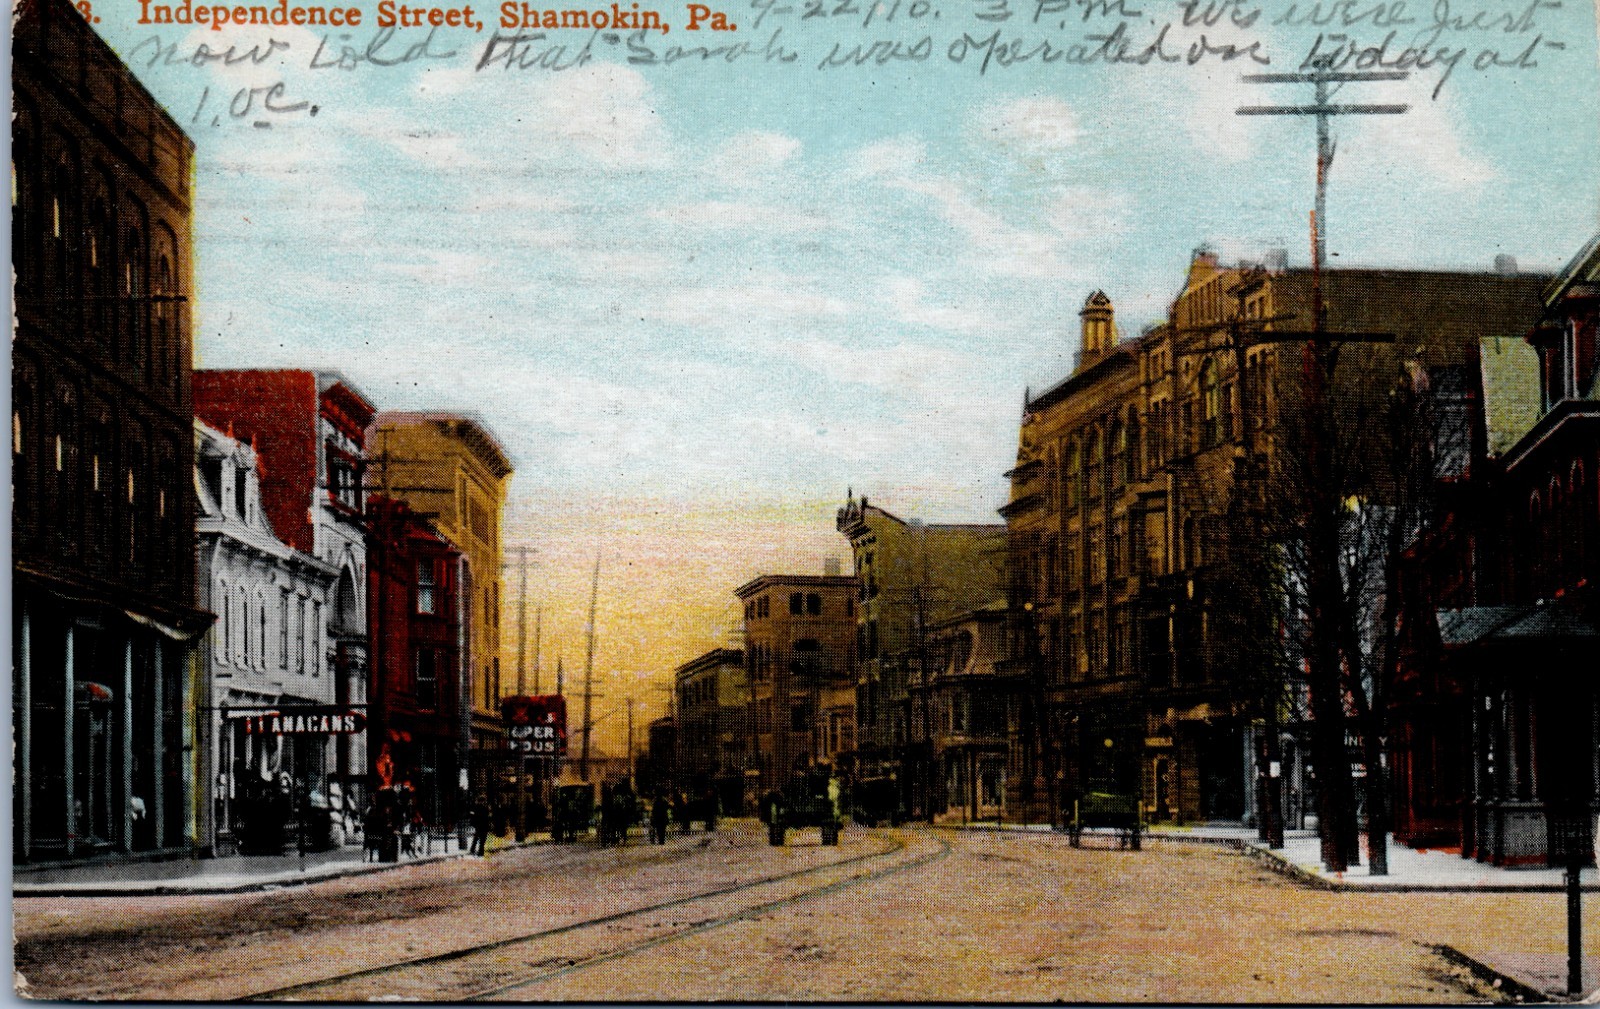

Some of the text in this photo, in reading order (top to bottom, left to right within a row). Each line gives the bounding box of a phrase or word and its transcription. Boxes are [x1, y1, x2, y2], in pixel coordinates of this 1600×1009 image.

[818, 35, 932, 71] was
[947, 22, 1181, 75] operated
[510, 725, 560, 739] OPER
